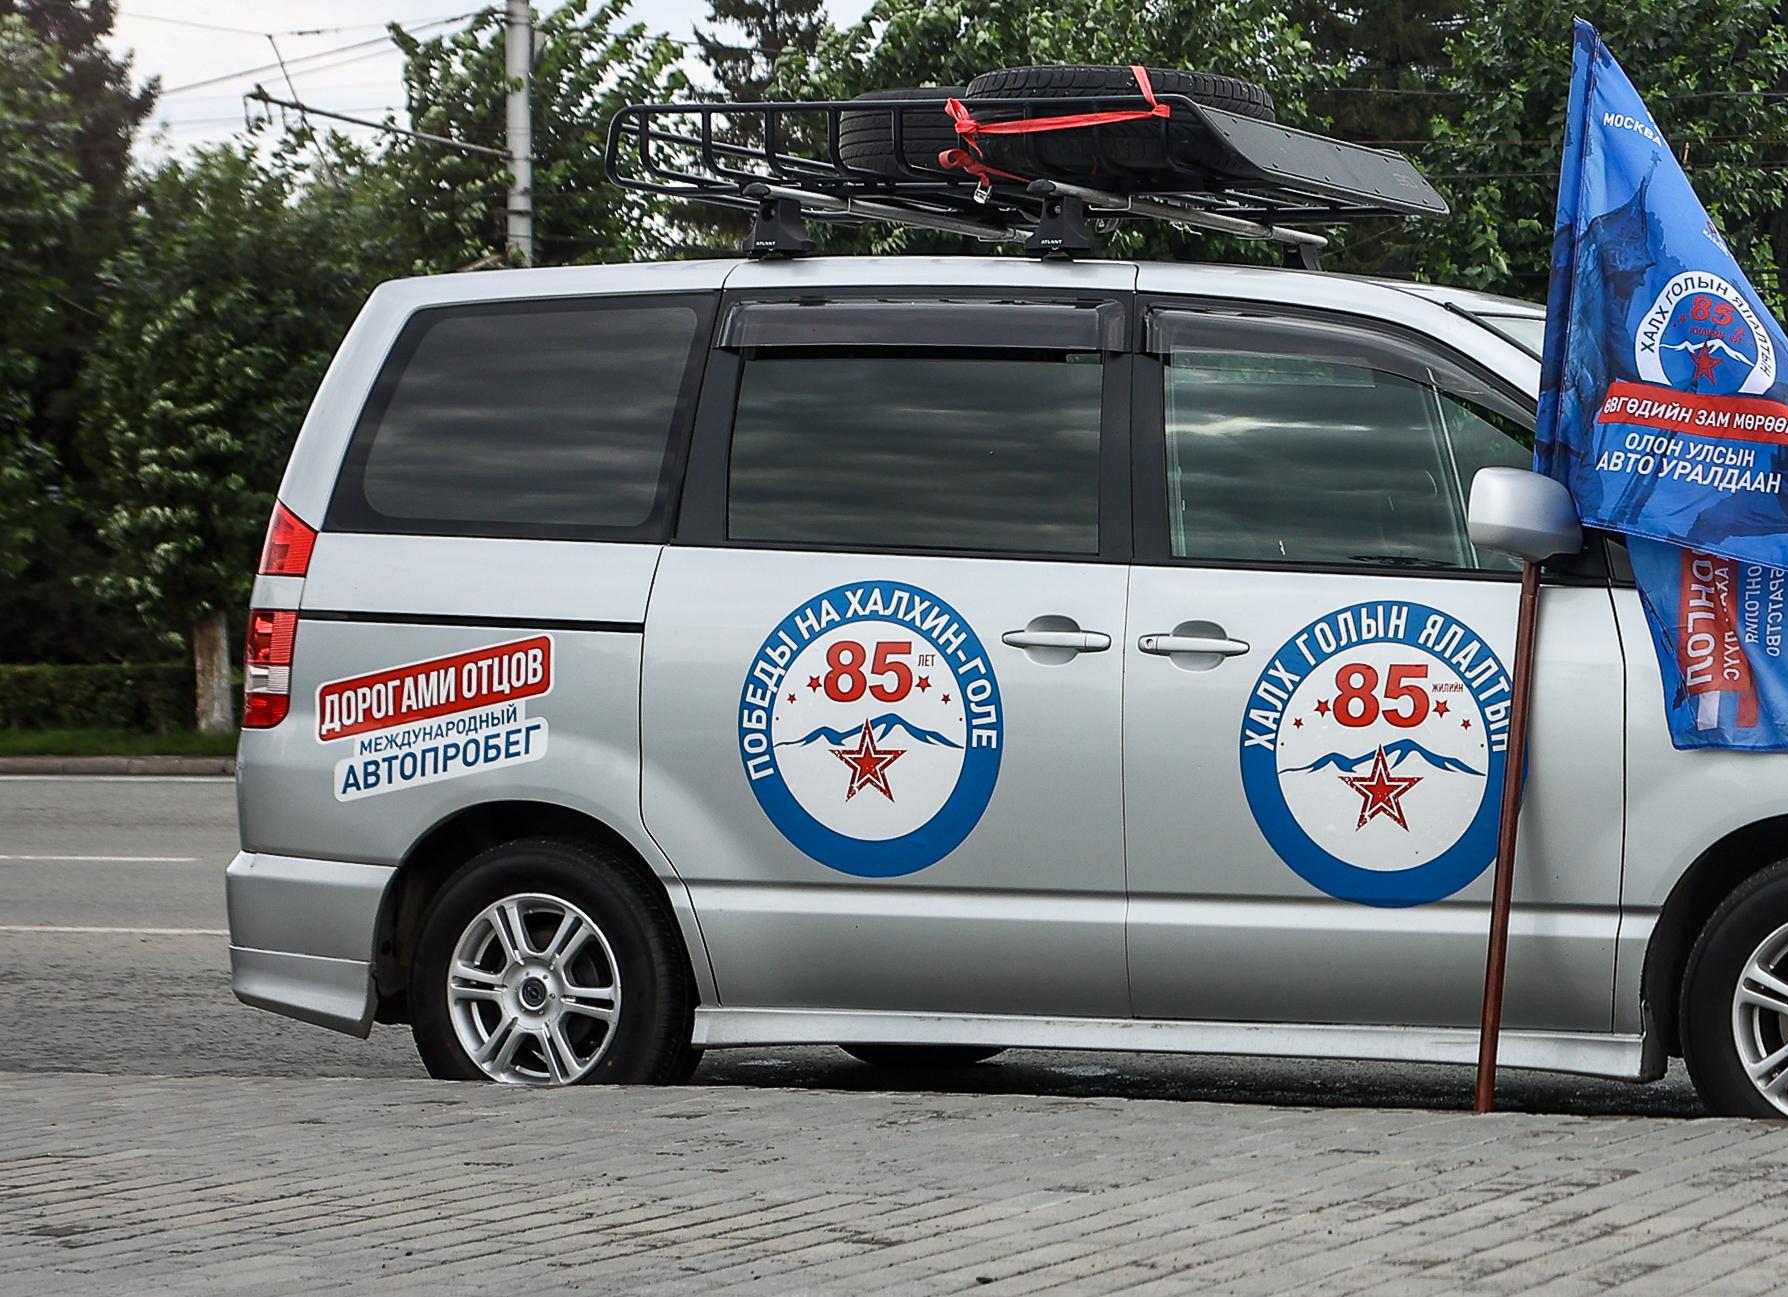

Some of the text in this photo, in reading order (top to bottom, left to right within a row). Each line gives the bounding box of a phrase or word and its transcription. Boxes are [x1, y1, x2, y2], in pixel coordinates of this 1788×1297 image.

[1603, 112, 1662, 147] МОСКВА
[1640, 305, 1669, 353] ХАЛХ
[1666, 276, 1728, 305] ГОЛЫН
[1690, 295, 1735, 326] 85
[1624, 432, 1756, 468] ОЛОН УЛСЫН
[1695, 409, 1731, 428] ЗАМ
[1595, 450, 1782, 494] АВТО УРАЛДААН
[321, 648, 543, 735] ДОРОГАМИ ОТЦОВ
[742, 588, 998, 780] ПОБЕДЫ НА ХАЛХИН-ГОЛЕ
[823, 640, 936, 703] 85 ЛЕТ
[1244, 659, 1303, 751] ХАЛХ
[1295, 605, 1408, 666] ГОЛЫН
[1332, 663, 1430, 728] 85
[342, 724, 541, 795] АВТОПРОБЕГ
[360, 704, 518, 756] МЕЖДУНАРОДНЫЙ
